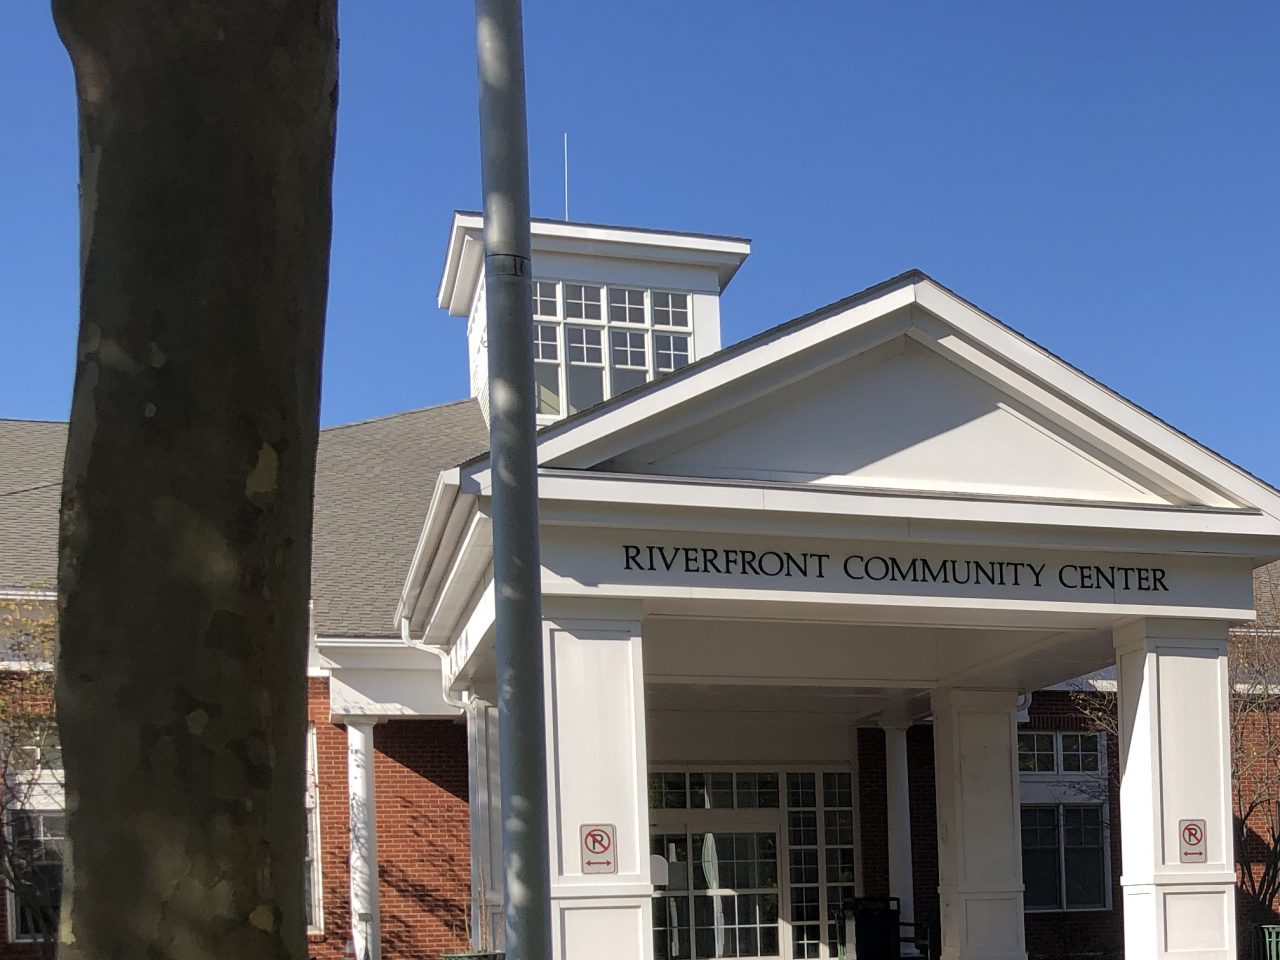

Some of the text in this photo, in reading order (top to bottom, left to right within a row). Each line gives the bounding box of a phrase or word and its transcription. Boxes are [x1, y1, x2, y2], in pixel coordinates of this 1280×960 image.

[623, 545, 1169, 592] RIVERFRONT COMMUNITY CENTER
